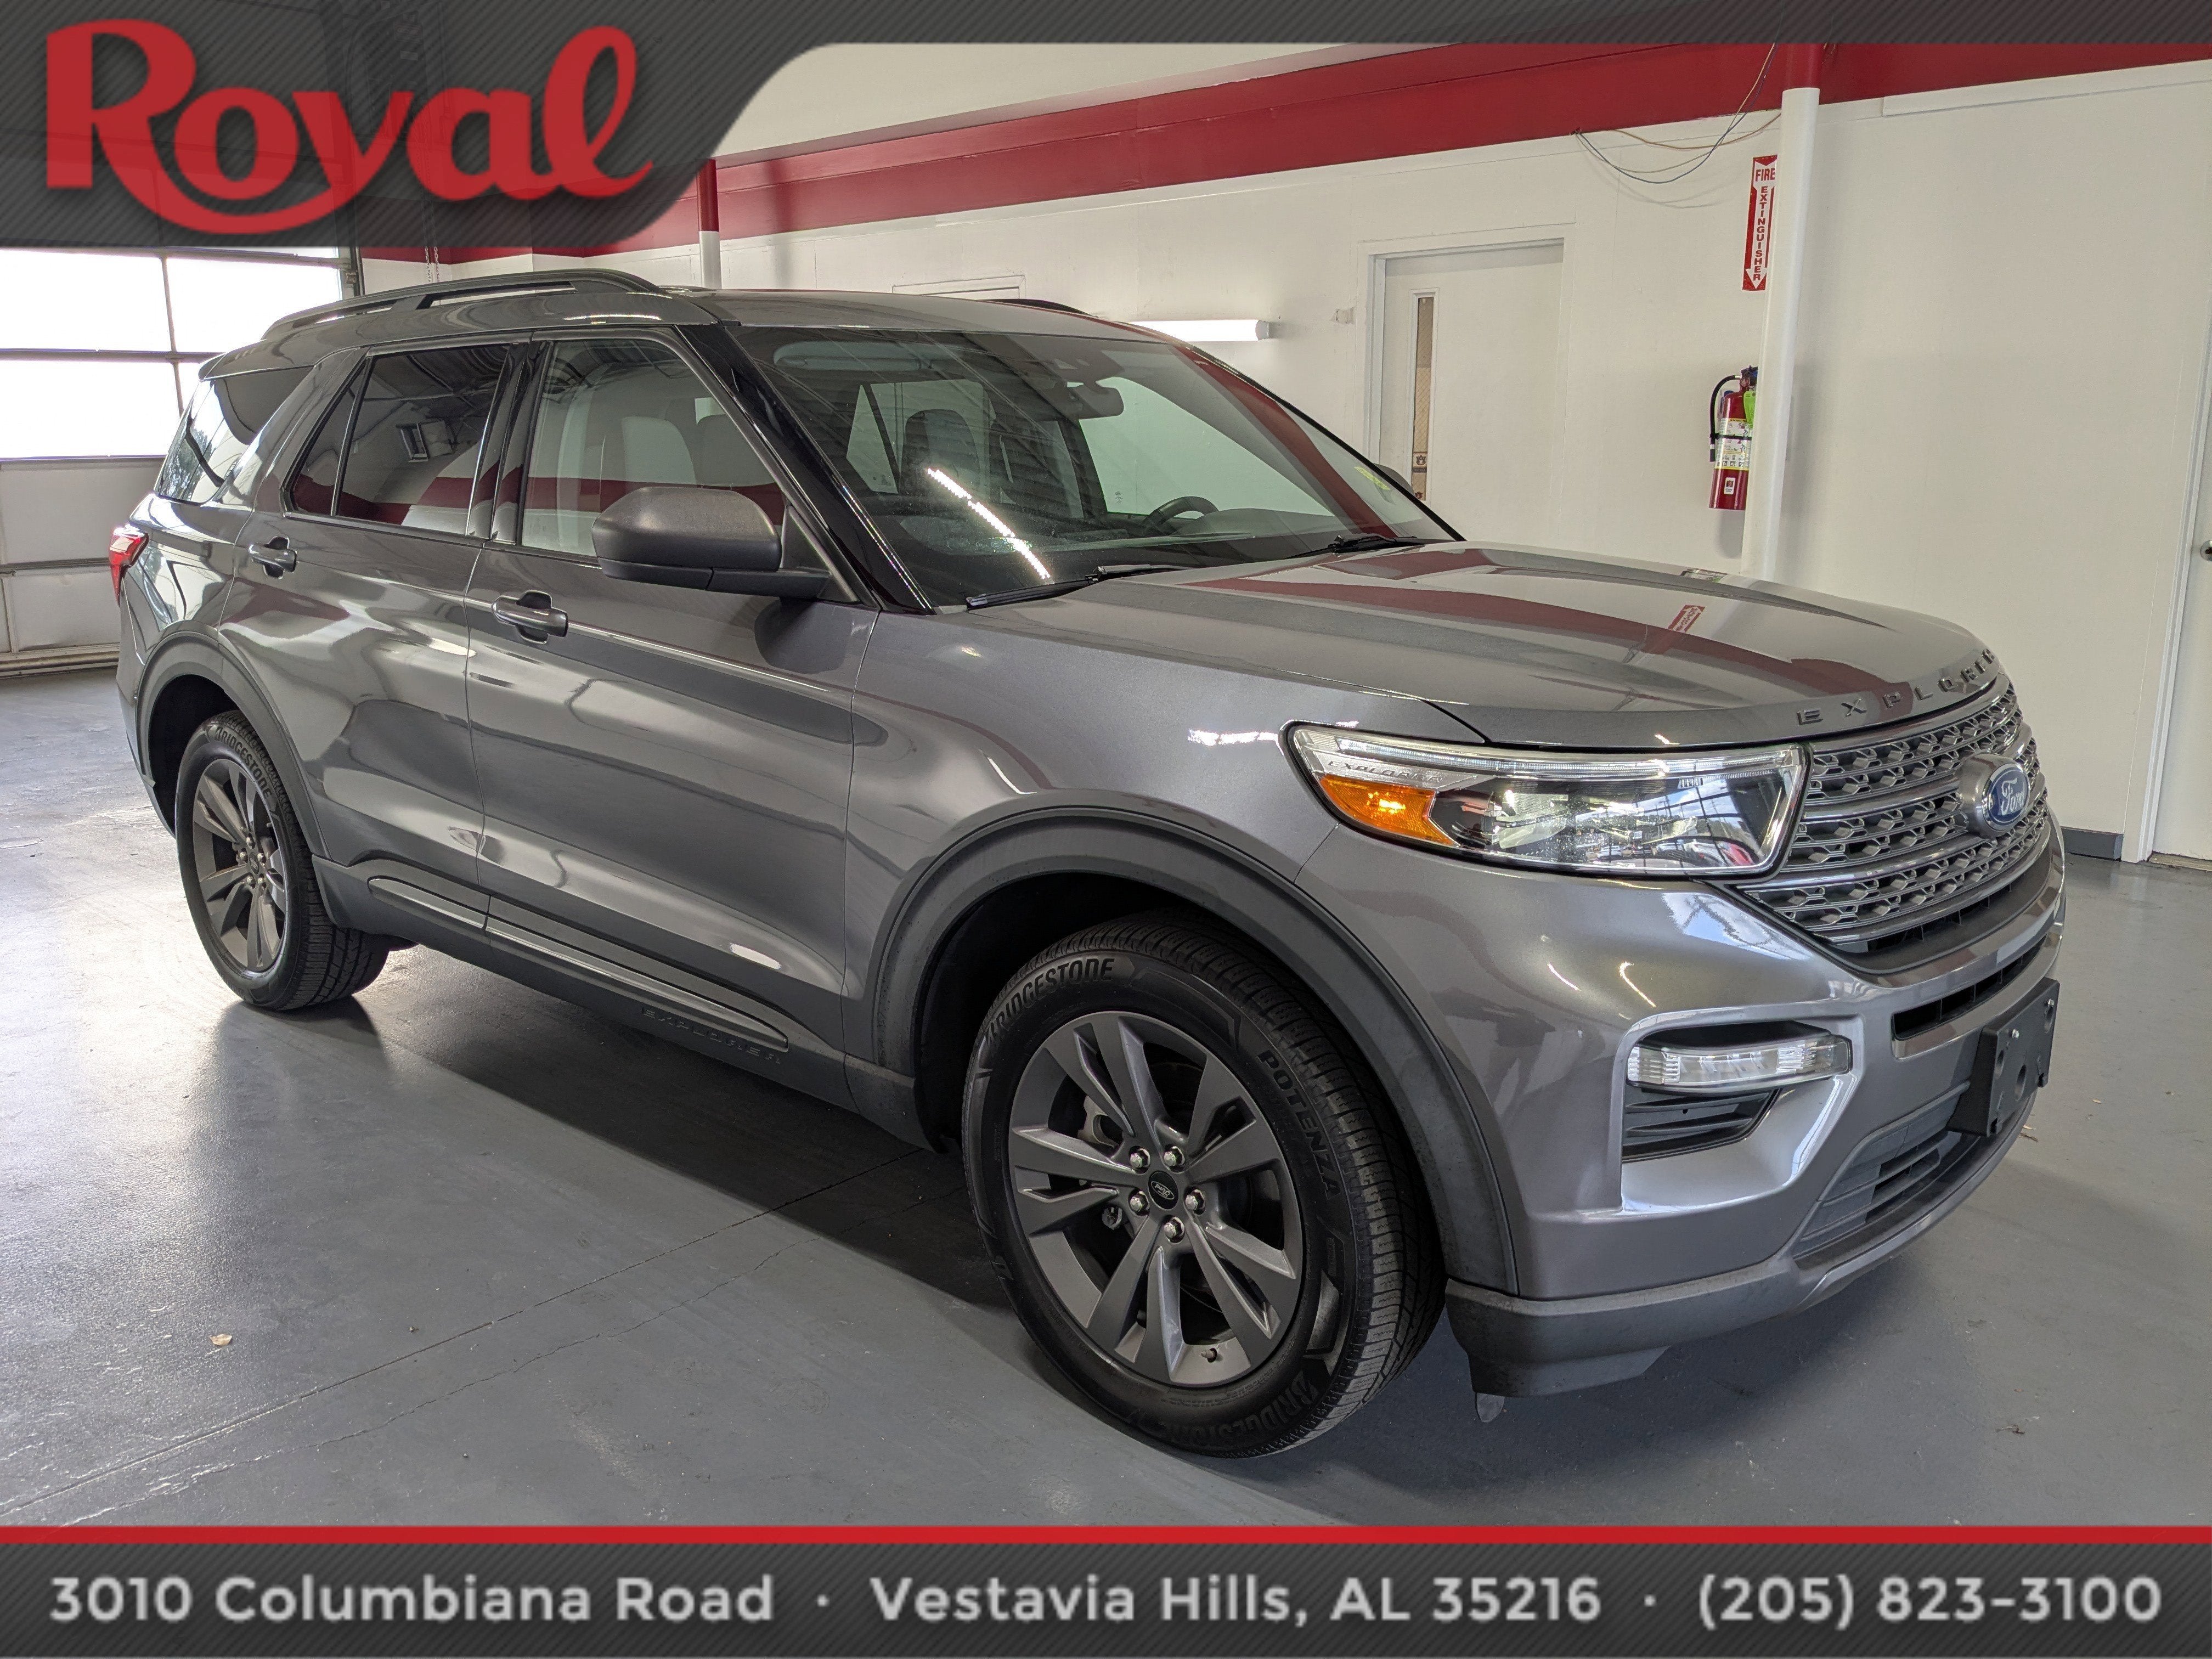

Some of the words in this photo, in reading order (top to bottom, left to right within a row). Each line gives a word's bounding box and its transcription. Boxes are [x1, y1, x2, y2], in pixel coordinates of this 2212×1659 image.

[1755, 167, 1776, 182] FIRE
[1753, 185, 1768, 281] EXTINGUISHER
[1796, 648, 1995, 726] EXPLORER
[214, 725, 272, 799] BRIDGESTONE
[1328, 760, 1443, 783] EXPLORER
[2000, 777, 2025, 816] Ford
[641, 1006, 782, 1065] EXPLORER
[984, 957, 1115, 1047] BRIDGESTONE
[1256, 1049, 1342, 1200] POTENZA
